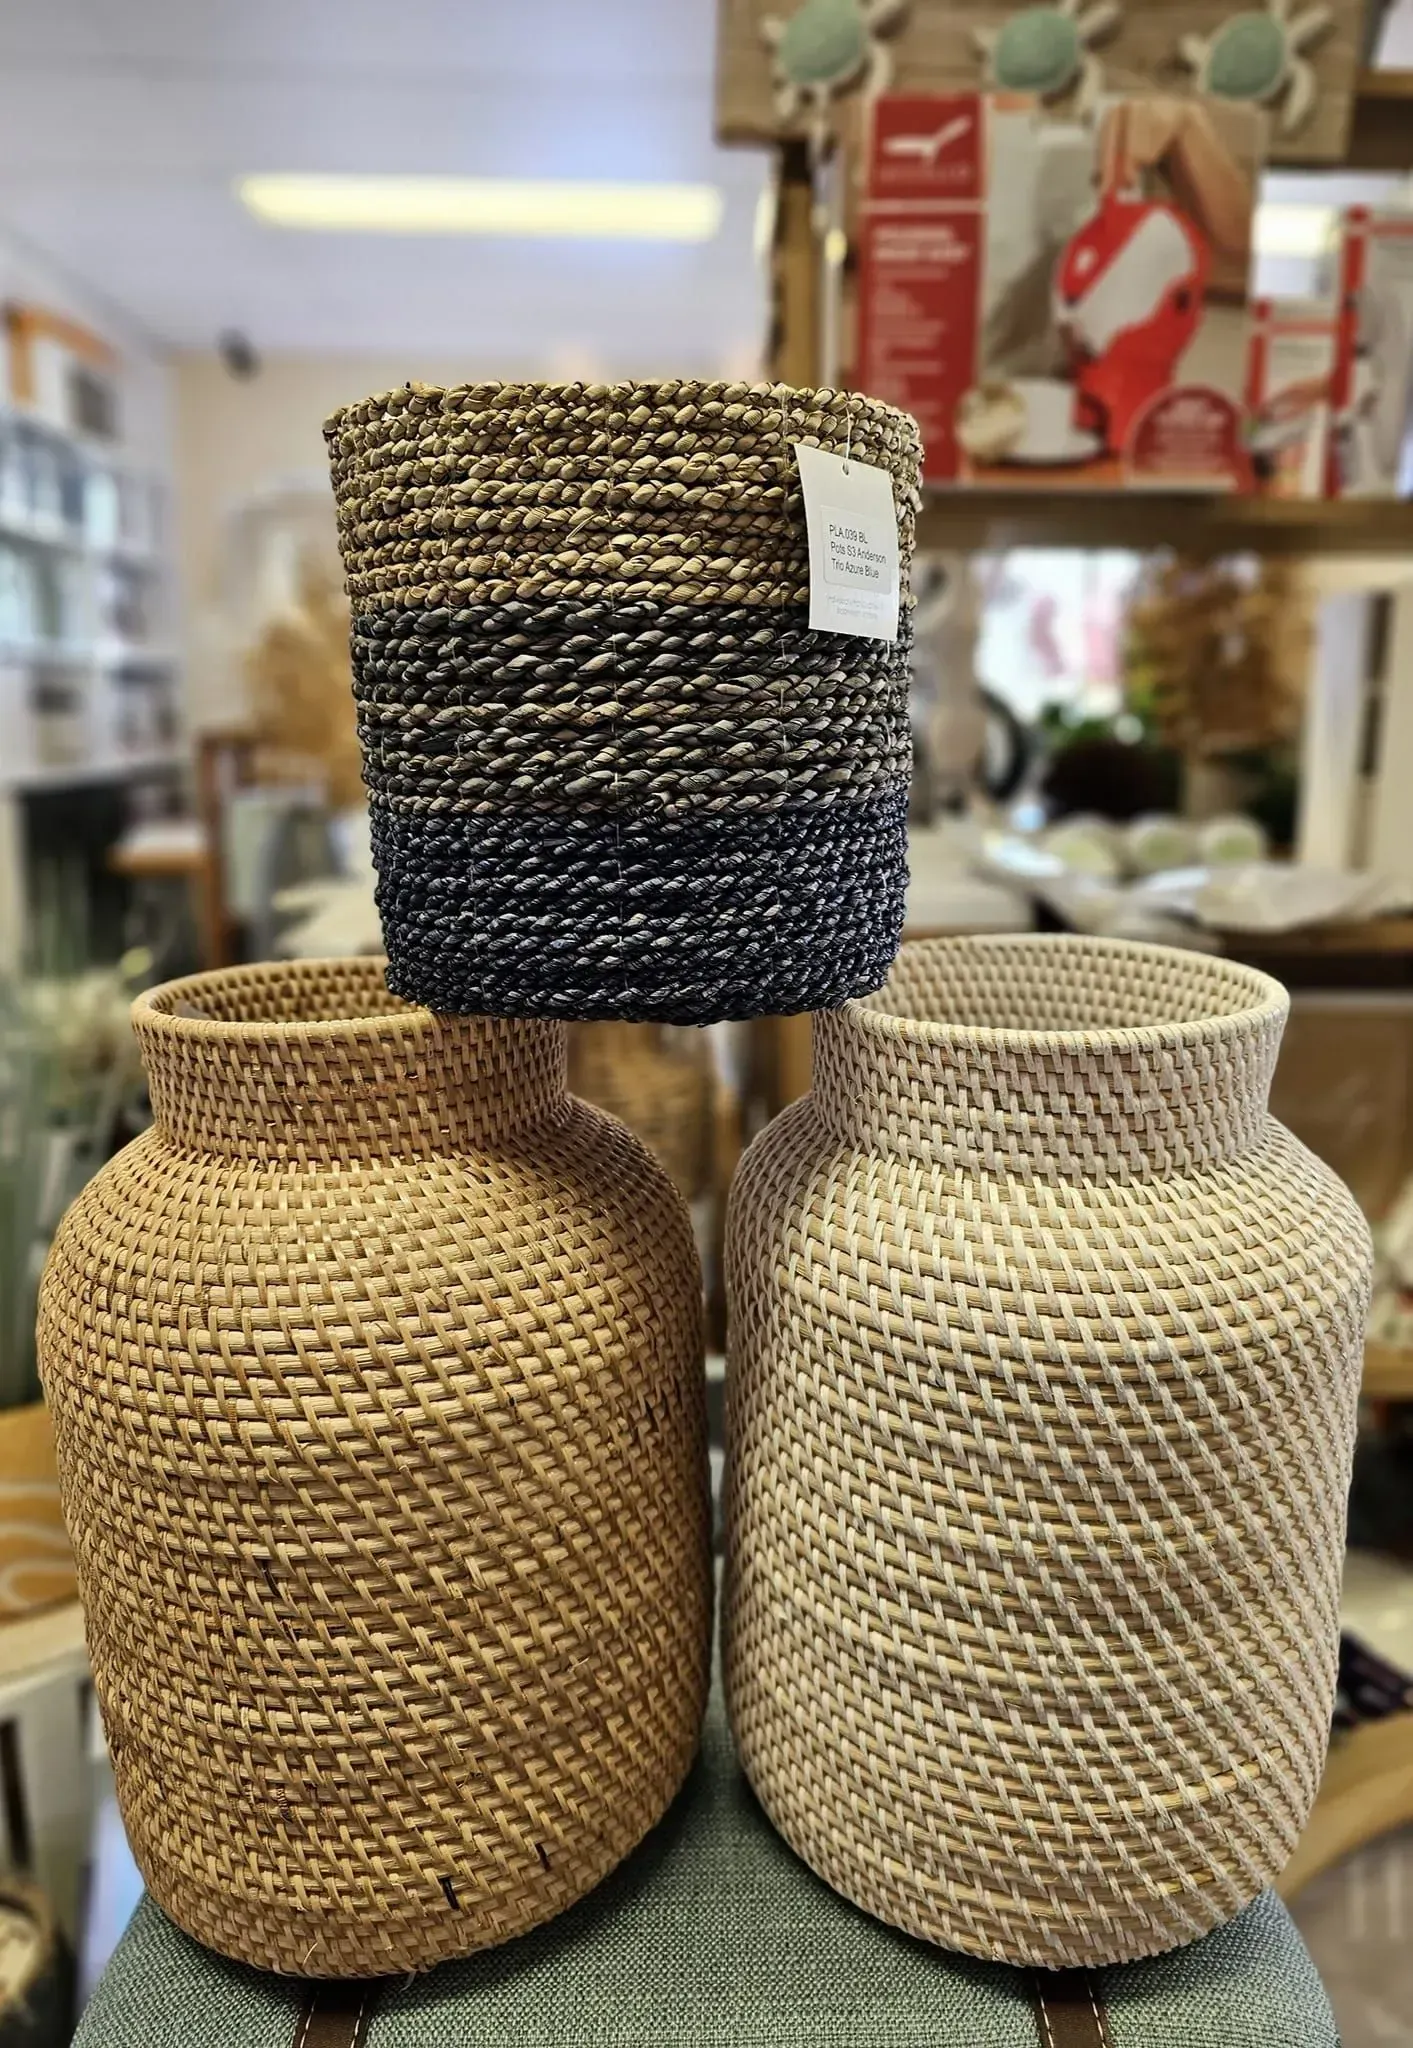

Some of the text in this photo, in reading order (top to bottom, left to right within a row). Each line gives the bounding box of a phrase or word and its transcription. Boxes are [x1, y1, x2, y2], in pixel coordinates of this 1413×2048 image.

[829, 524, 868, 544] PLA.039 BL
[830, 541, 886, 564] Pots S3 Anderson
[831, 558, 879, 579] Trio Azure Blue
